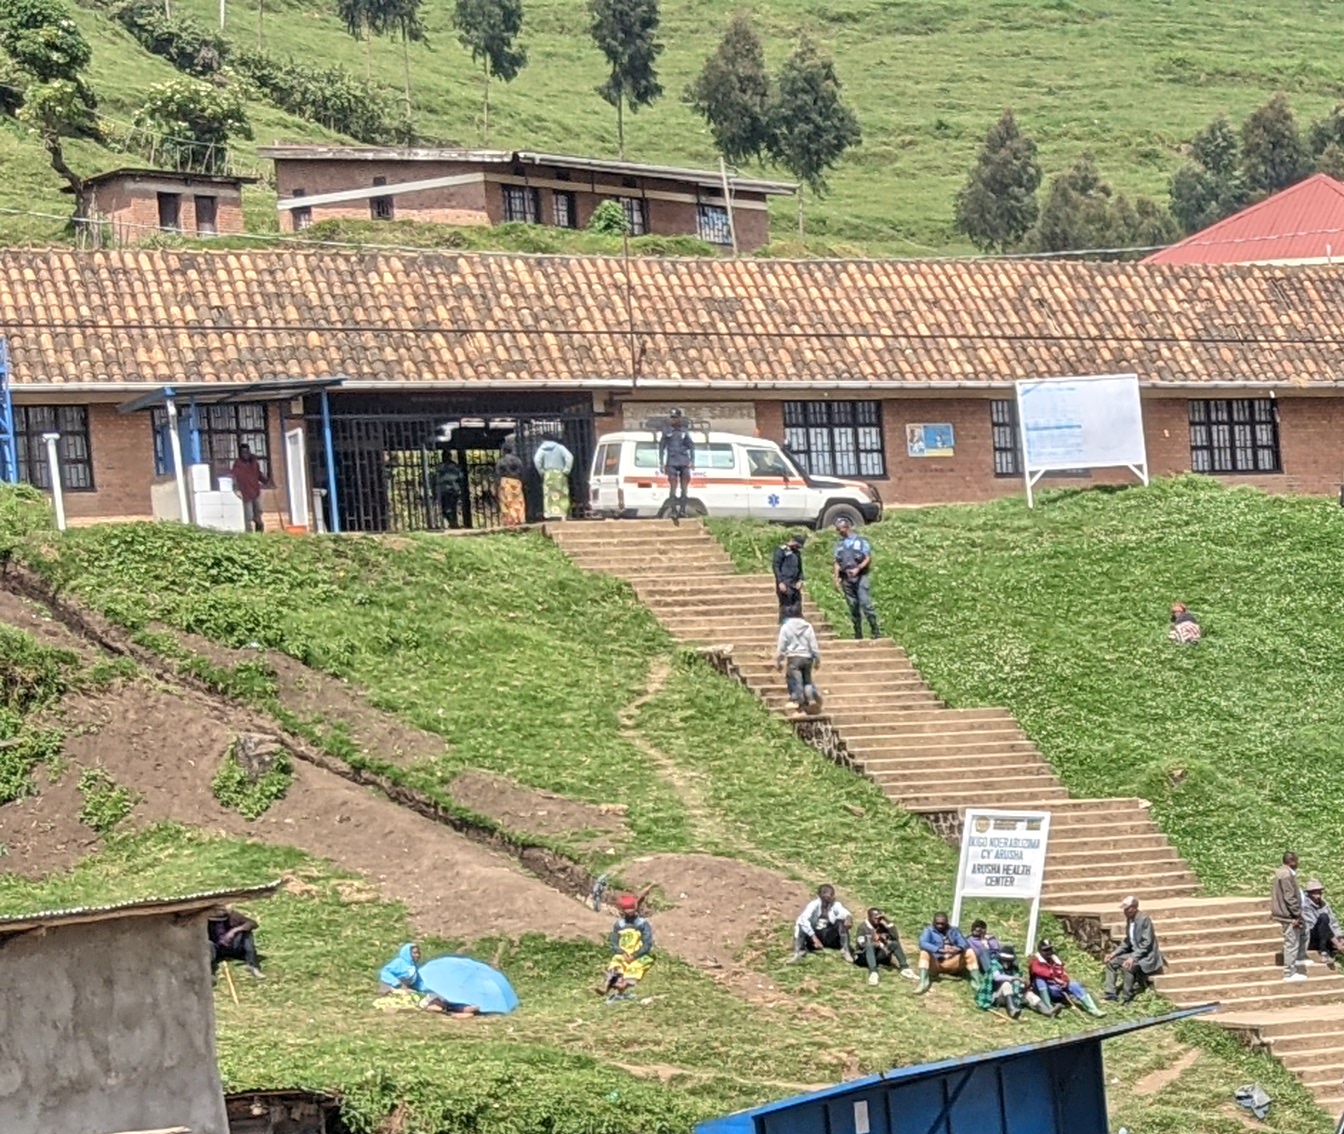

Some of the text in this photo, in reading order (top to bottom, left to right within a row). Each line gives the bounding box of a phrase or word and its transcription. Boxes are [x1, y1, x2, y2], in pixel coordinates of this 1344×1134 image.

[994, 849, 1023, 860] ARUSHA
[971, 863, 1031, 876] ARUSHA HEALTH
[985, 876, 1015, 887] CENTER
